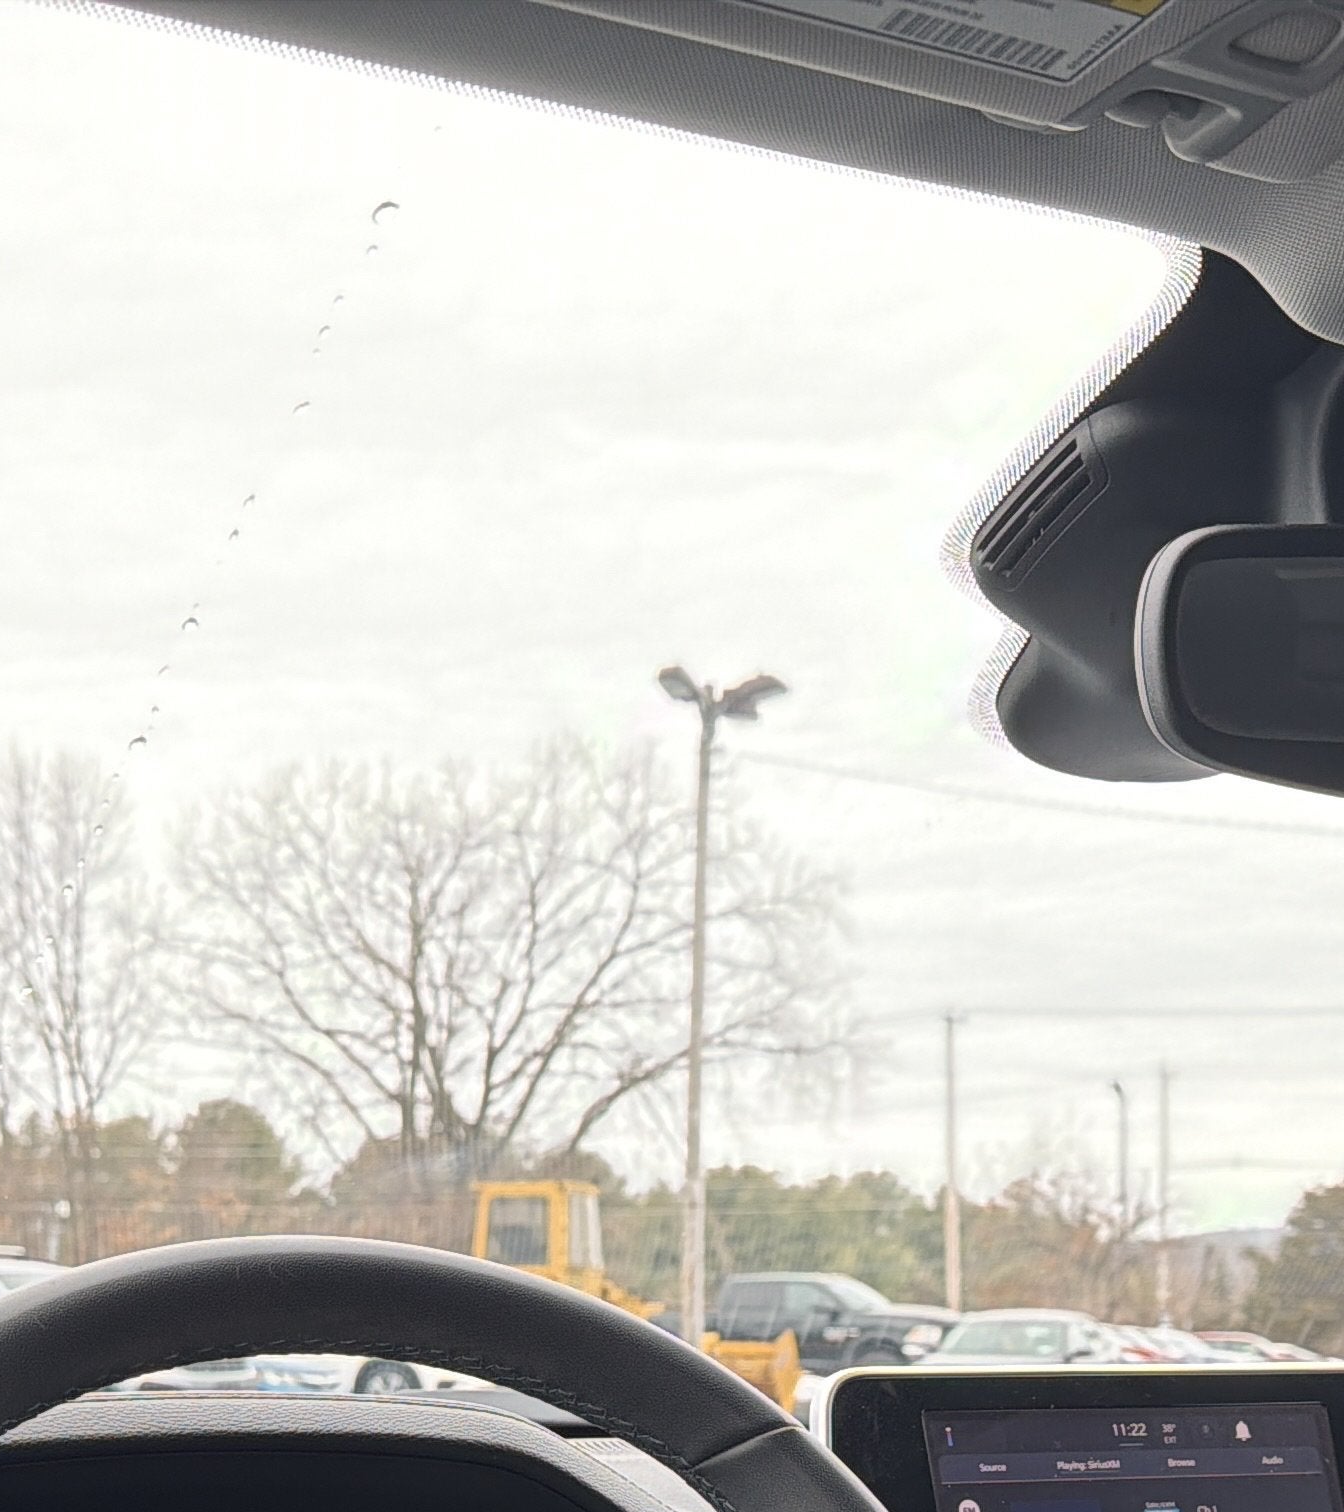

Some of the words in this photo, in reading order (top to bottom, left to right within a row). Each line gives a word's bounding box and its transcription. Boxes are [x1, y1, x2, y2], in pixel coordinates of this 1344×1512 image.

[1112, 1422, 1148, 1439] 11:22
[1167, 1457, 1196, 1469] Browse
[1261, 1455, 1285, 1466] Audio
[978, 1462, 1008, 1474] Source
